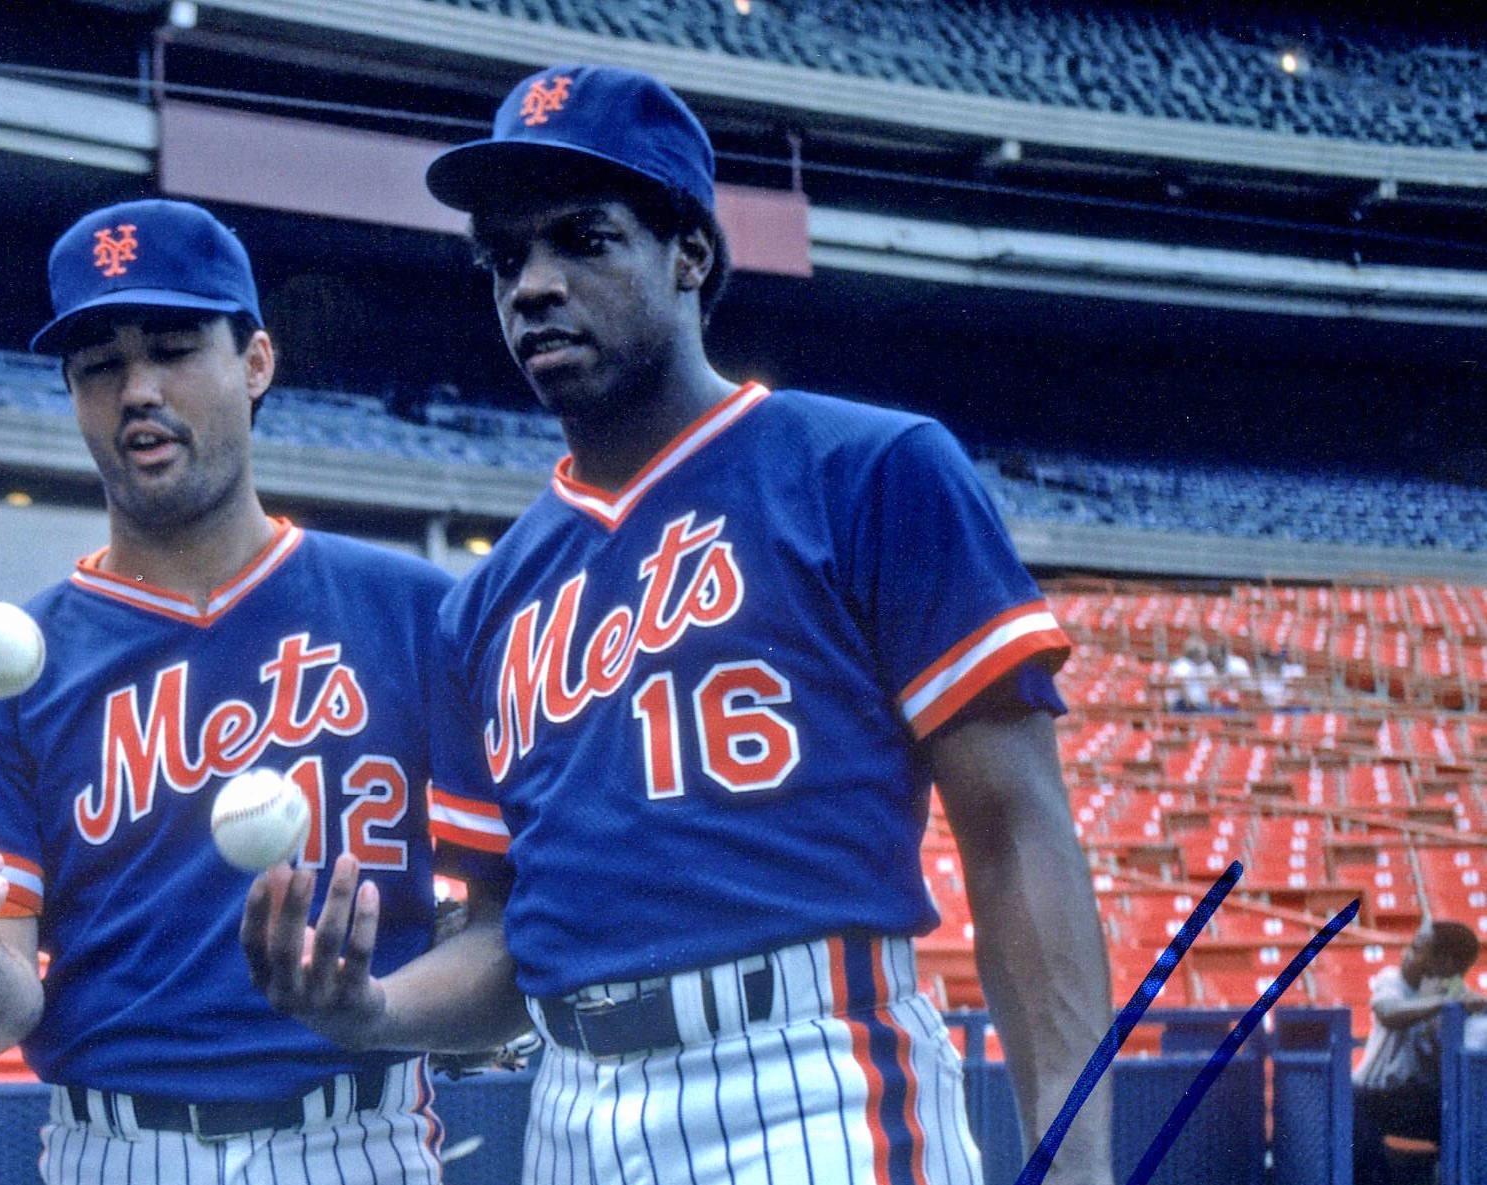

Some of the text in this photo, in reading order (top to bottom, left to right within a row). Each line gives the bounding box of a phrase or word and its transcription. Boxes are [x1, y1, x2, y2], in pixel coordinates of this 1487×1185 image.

[485, 510, 744, 784] Mets
[632, 658, 801, 801] 16
[74, 632, 369, 845] Mets
[284, 755, 409, 872] 12
